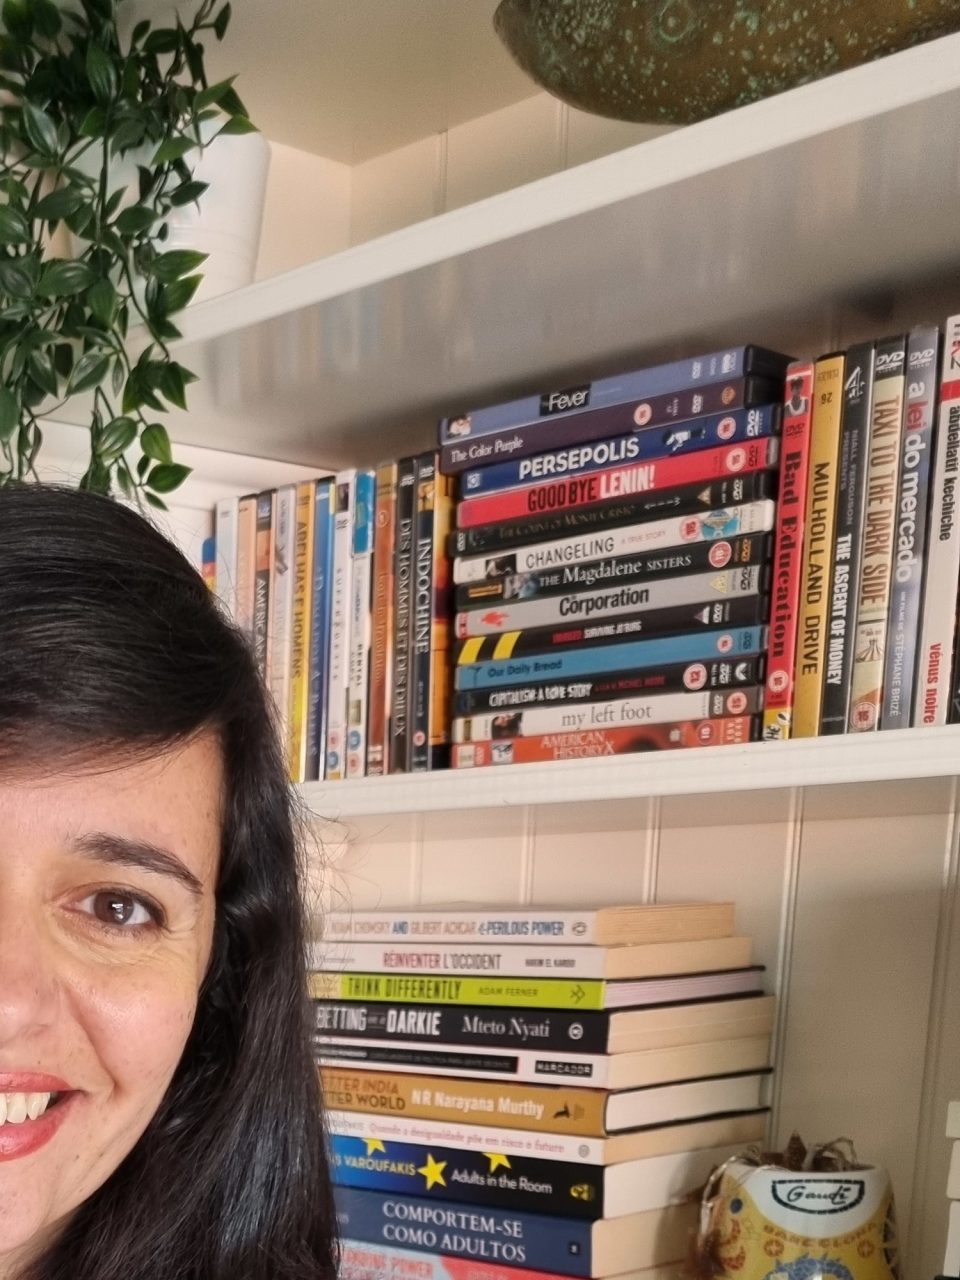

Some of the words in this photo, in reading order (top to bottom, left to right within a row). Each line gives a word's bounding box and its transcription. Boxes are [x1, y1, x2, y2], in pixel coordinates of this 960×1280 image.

[548, 389, 589, 412] Fever
[908, 381, 926, 397] a
[872, 395, 900, 439] TAXI
[907, 400, 929, 431] lei
[451, 448, 468, 463] The
[468, 444, 493, 459] Color
[494, 436, 524, 454] Purple
[518, 436, 640, 481] PERSEPOLIS
[870, 440, 897, 468] TO
[904, 433, 926, 468] do
[600, 464, 655, 499] LENIN!
[783, 451, 802, 505] Bad
[868, 470, 896, 508] THE
[399, 519, 412, 553] DES
[807, 462, 831, 605] MULHOLLAND
[864, 508, 892, 559] DARK
[896, 473, 921, 583] mercado
[526, 537, 615, 569] CHANGELING
[836, 532, 853, 559] THE
[540, 575, 561, 587] THE
[562, 559, 643, 586] Magdalene
[646, 554, 692, 572] SISTERS
[773, 517, 799, 657] Education
[860, 563, 889, 607] SIDE
[397, 554, 411, 630] HOMMES
[416, 538, 432, 655] INDOCHINE
[559, 587, 650, 617] Corporation
[832, 563, 852, 615] ASCENT
[831, 616, 847, 634] OF
[801, 614, 821, 676] DRIVE
[826, 634, 844, 685] MONEY
[487, 667, 505, 678] Our
[506, 664, 530, 676] Daily
[533, 659, 563, 672] Bread
[928, 642, 942, 686] vénus
[394, 688, 408, 737] DIEUX
[562, 710, 586, 730] my
[590, 703, 616, 724] left
[620, 702, 653, 721] foot
[923, 687, 937, 724] noire
[541, 731, 606, 749] AMERICAN
[392, 920, 409, 935] AND
[348, 977, 381, 997] THINK
[385, 977, 462, 1000] DIFFERENTLY
[478, 987, 503, 996] ADAM
[505, 987, 539, 998] FERNER
[316, 1006, 367, 1031] BETTING
[386, 1008, 442, 1036] DARKIE
[462, 1014, 506, 1035] Mteto
[508, 1017, 551, 1041] Nyati
[536, 1061, 592, 1075] MARCADOR
[356, 1093, 407, 1111] WORLD
[361, 1079, 400, 1095] INDIA
[434, 1091, 495, 1113] Narayana
[496, 1097, 545, 1121] Murthy
[343, 1155, 417, 1176] VAROUFAKIS
[451, 1168, 485, 1186] Adults
[487, 1174, 497, 1186] in
[498, 1175, 517, 1190] the
[518, 1176, 553, 1194] Room
[382, 1199, 524, 1239] COMPORTEM-SE
[382, 1223, 437, 1247] COMO
[440, 1233, 527, 1263] ADULTOS
